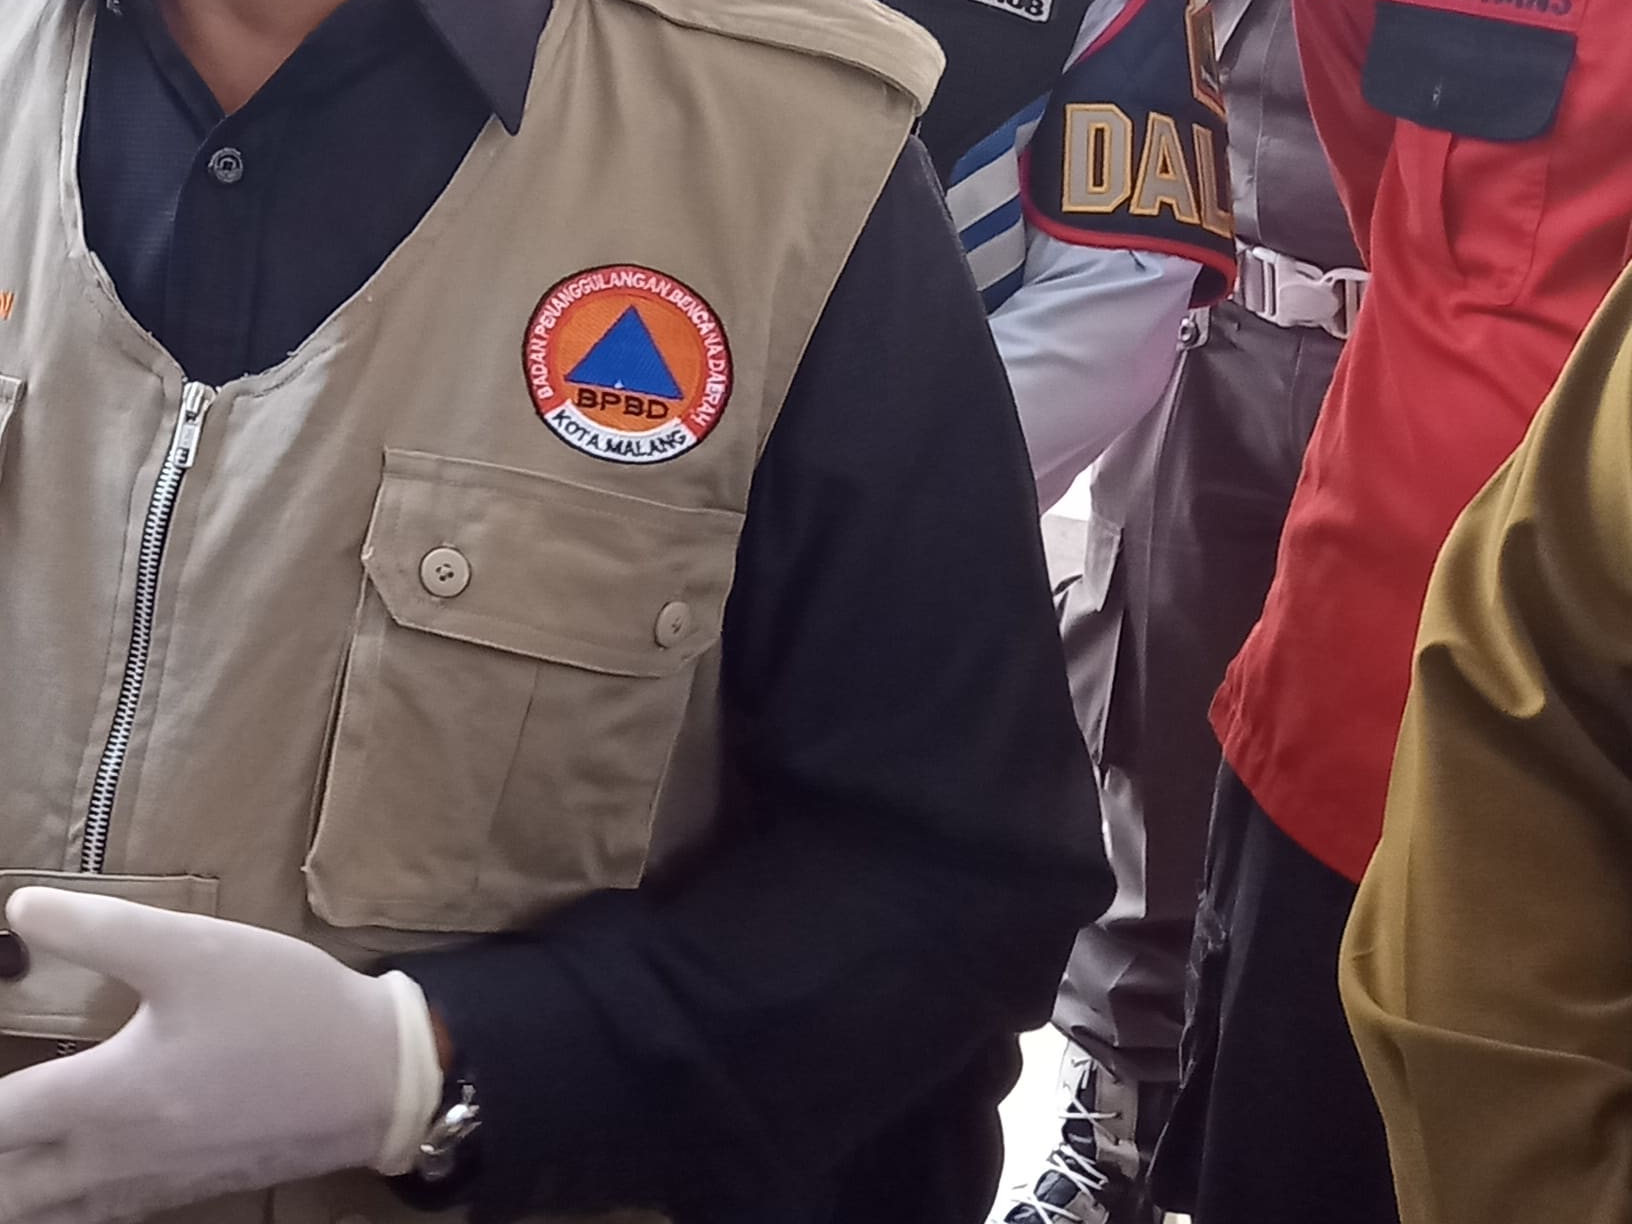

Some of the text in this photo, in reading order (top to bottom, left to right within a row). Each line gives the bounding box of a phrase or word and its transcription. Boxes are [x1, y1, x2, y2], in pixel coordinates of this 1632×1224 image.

[529, 271, 727, 427] BADAN PENANGGULANGAN BENCANA DAERAH
[575, 387, 670, 420] BPBD
[552, 408, 687, 457] KOTA MALANG
